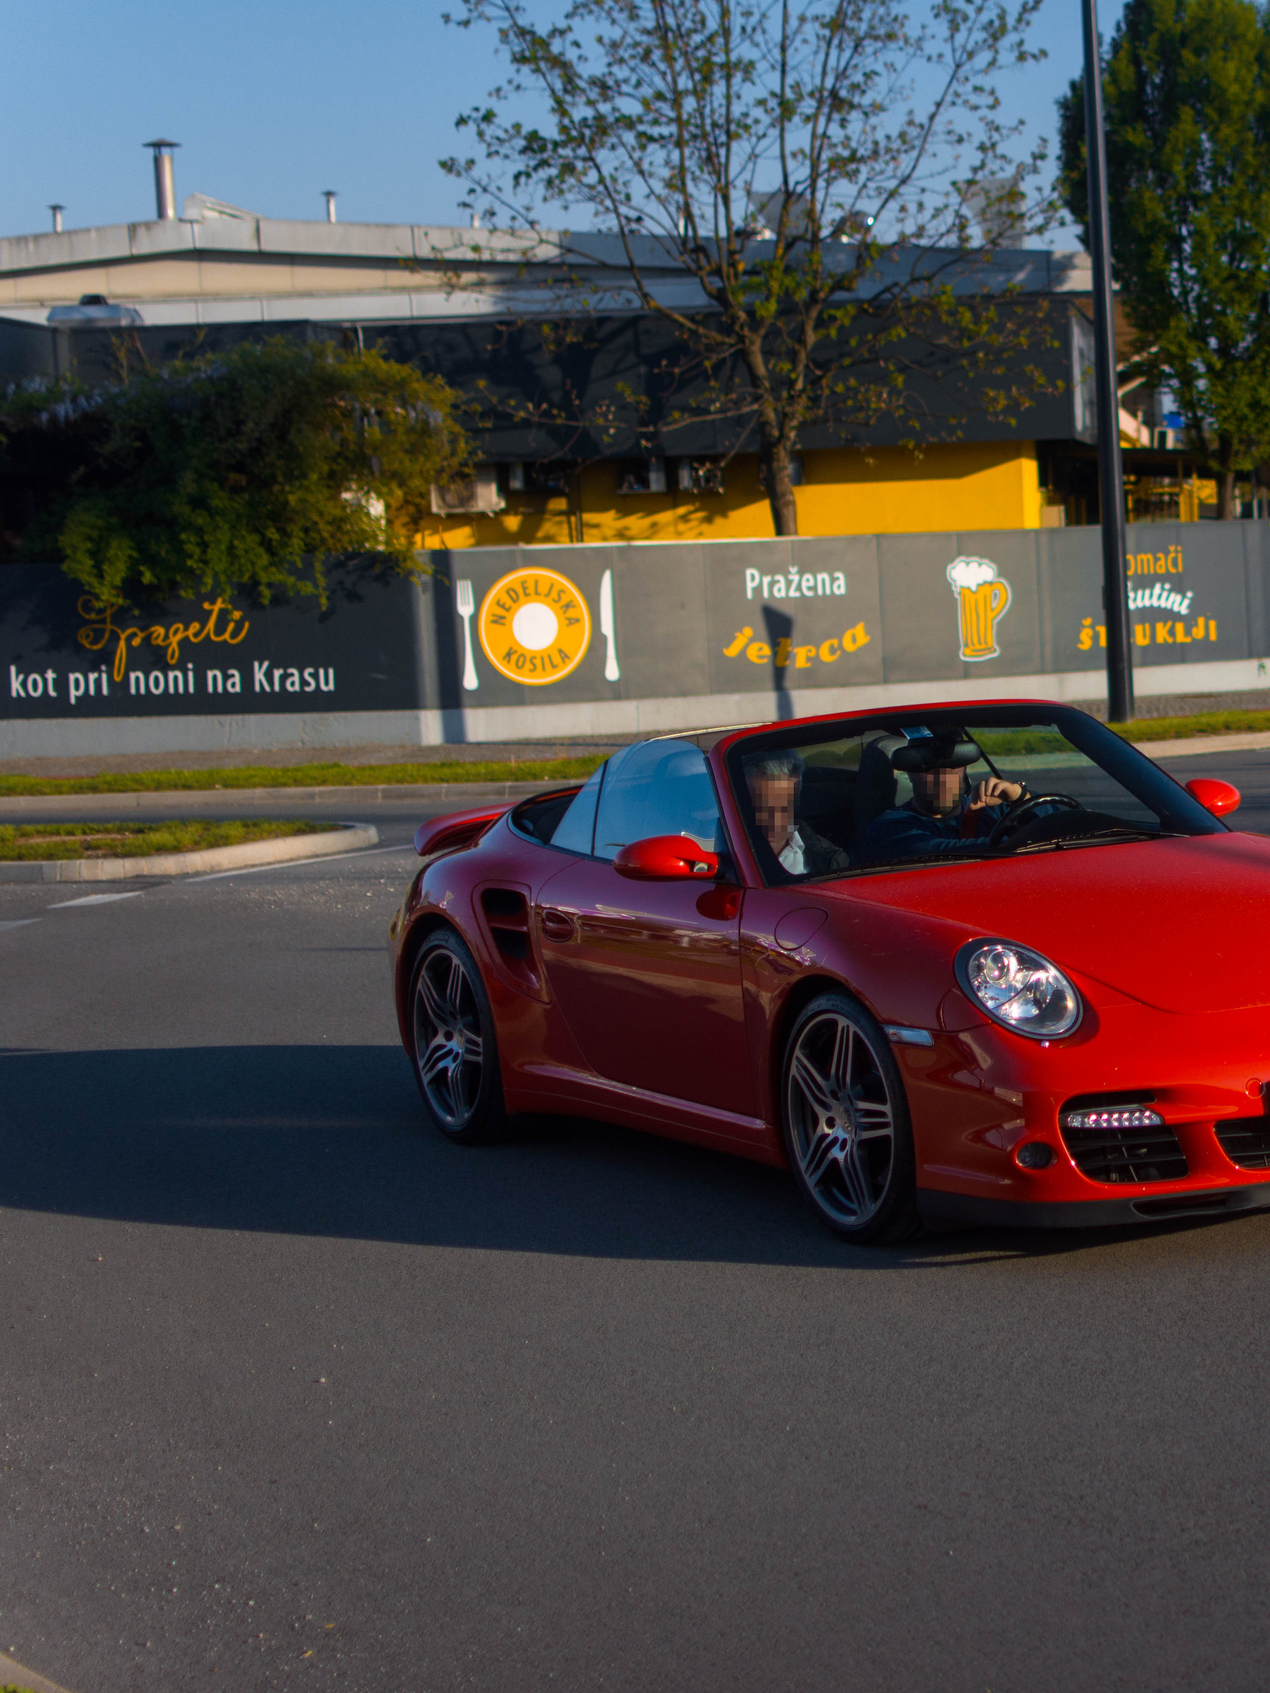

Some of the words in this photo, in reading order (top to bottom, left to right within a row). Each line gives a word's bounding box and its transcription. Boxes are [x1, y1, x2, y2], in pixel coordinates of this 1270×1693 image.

[1126, 545, 1183, 576] omači
[745, 565, 847, 600] Pražena
[1127, 580, 1194, 615] kutini
[490, 579, 581, 628] NEDELJSKA
[723, 621, 871, 669] jetrca
[1077, 617, 1217, 651] ŠTUKLJI
[502, 646, 571, 673] KOSILA
[10, 665, 57, 698] kot
[68, 665, 109, 705] pri
[129, 663, 195, 695] noni
[206, 669, 241, 693] na
[253, 660, 335, 693] Krasu
